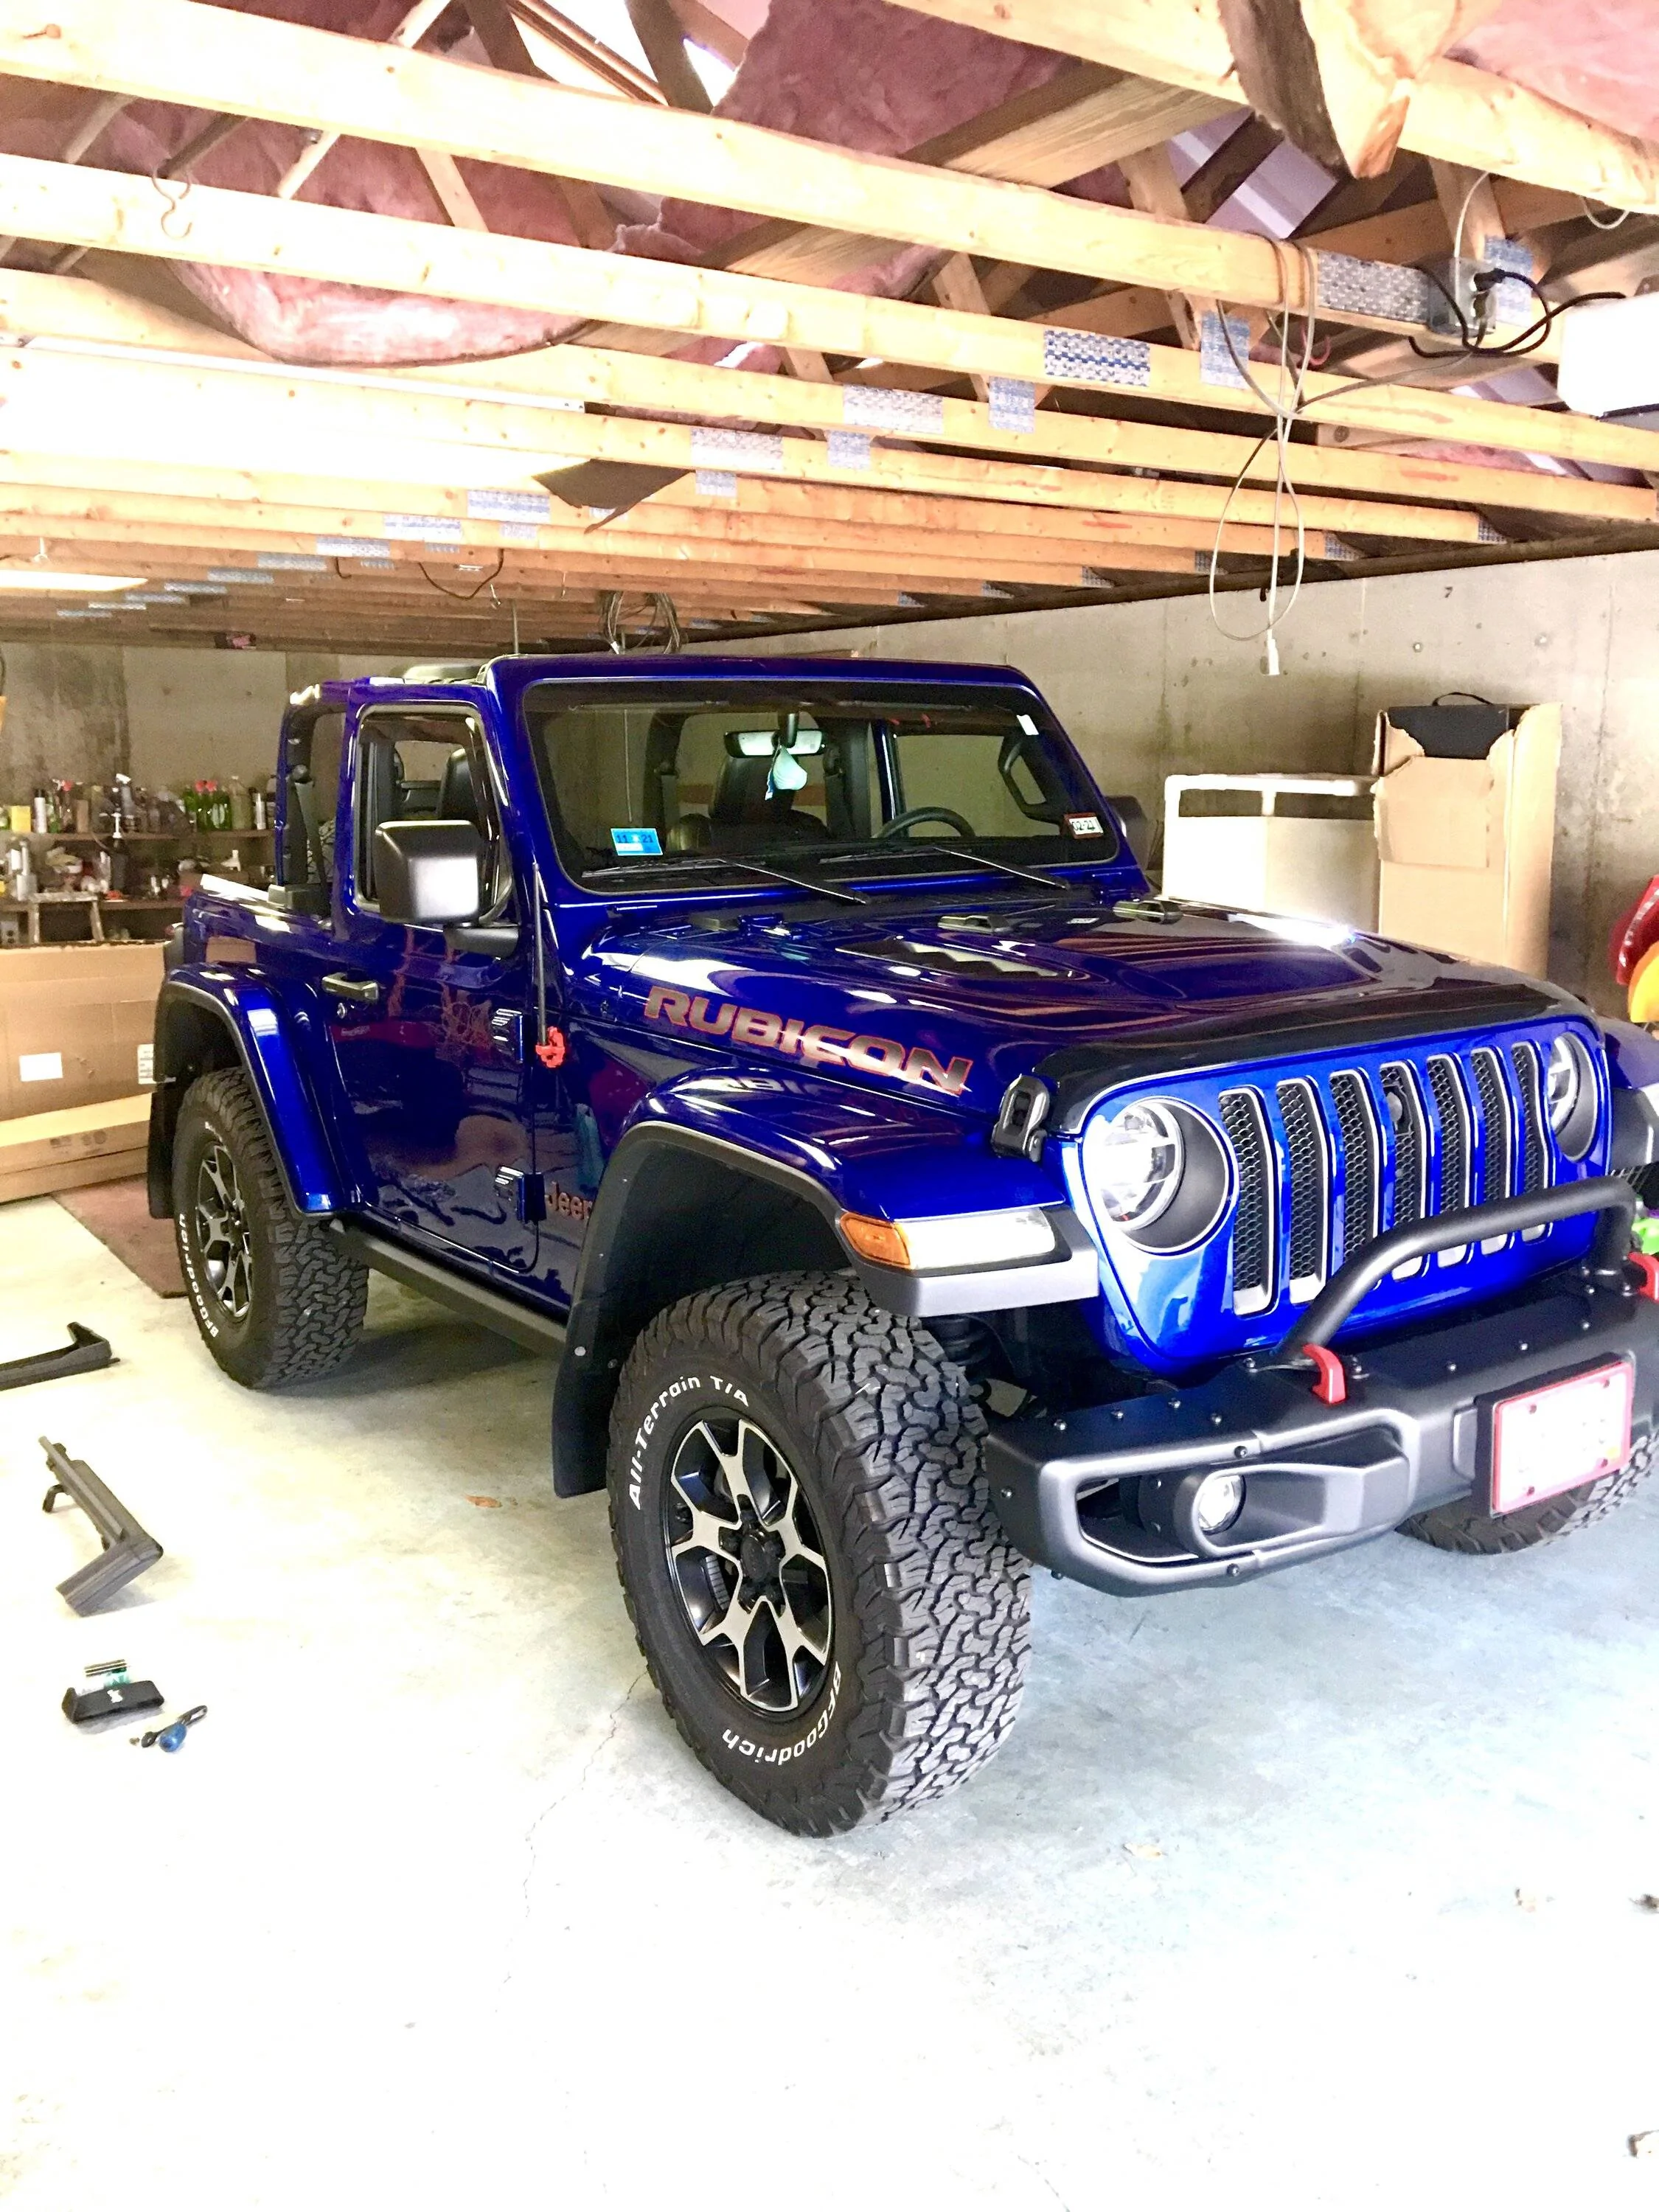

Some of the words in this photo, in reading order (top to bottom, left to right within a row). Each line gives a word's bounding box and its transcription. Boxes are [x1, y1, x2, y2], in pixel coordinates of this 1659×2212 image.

[644, 986, 974, 1096] RUBICON
[629, 1376, 701, 1511] All-Terrain
[722, 1660, 842, 1766] BFGoodrich
